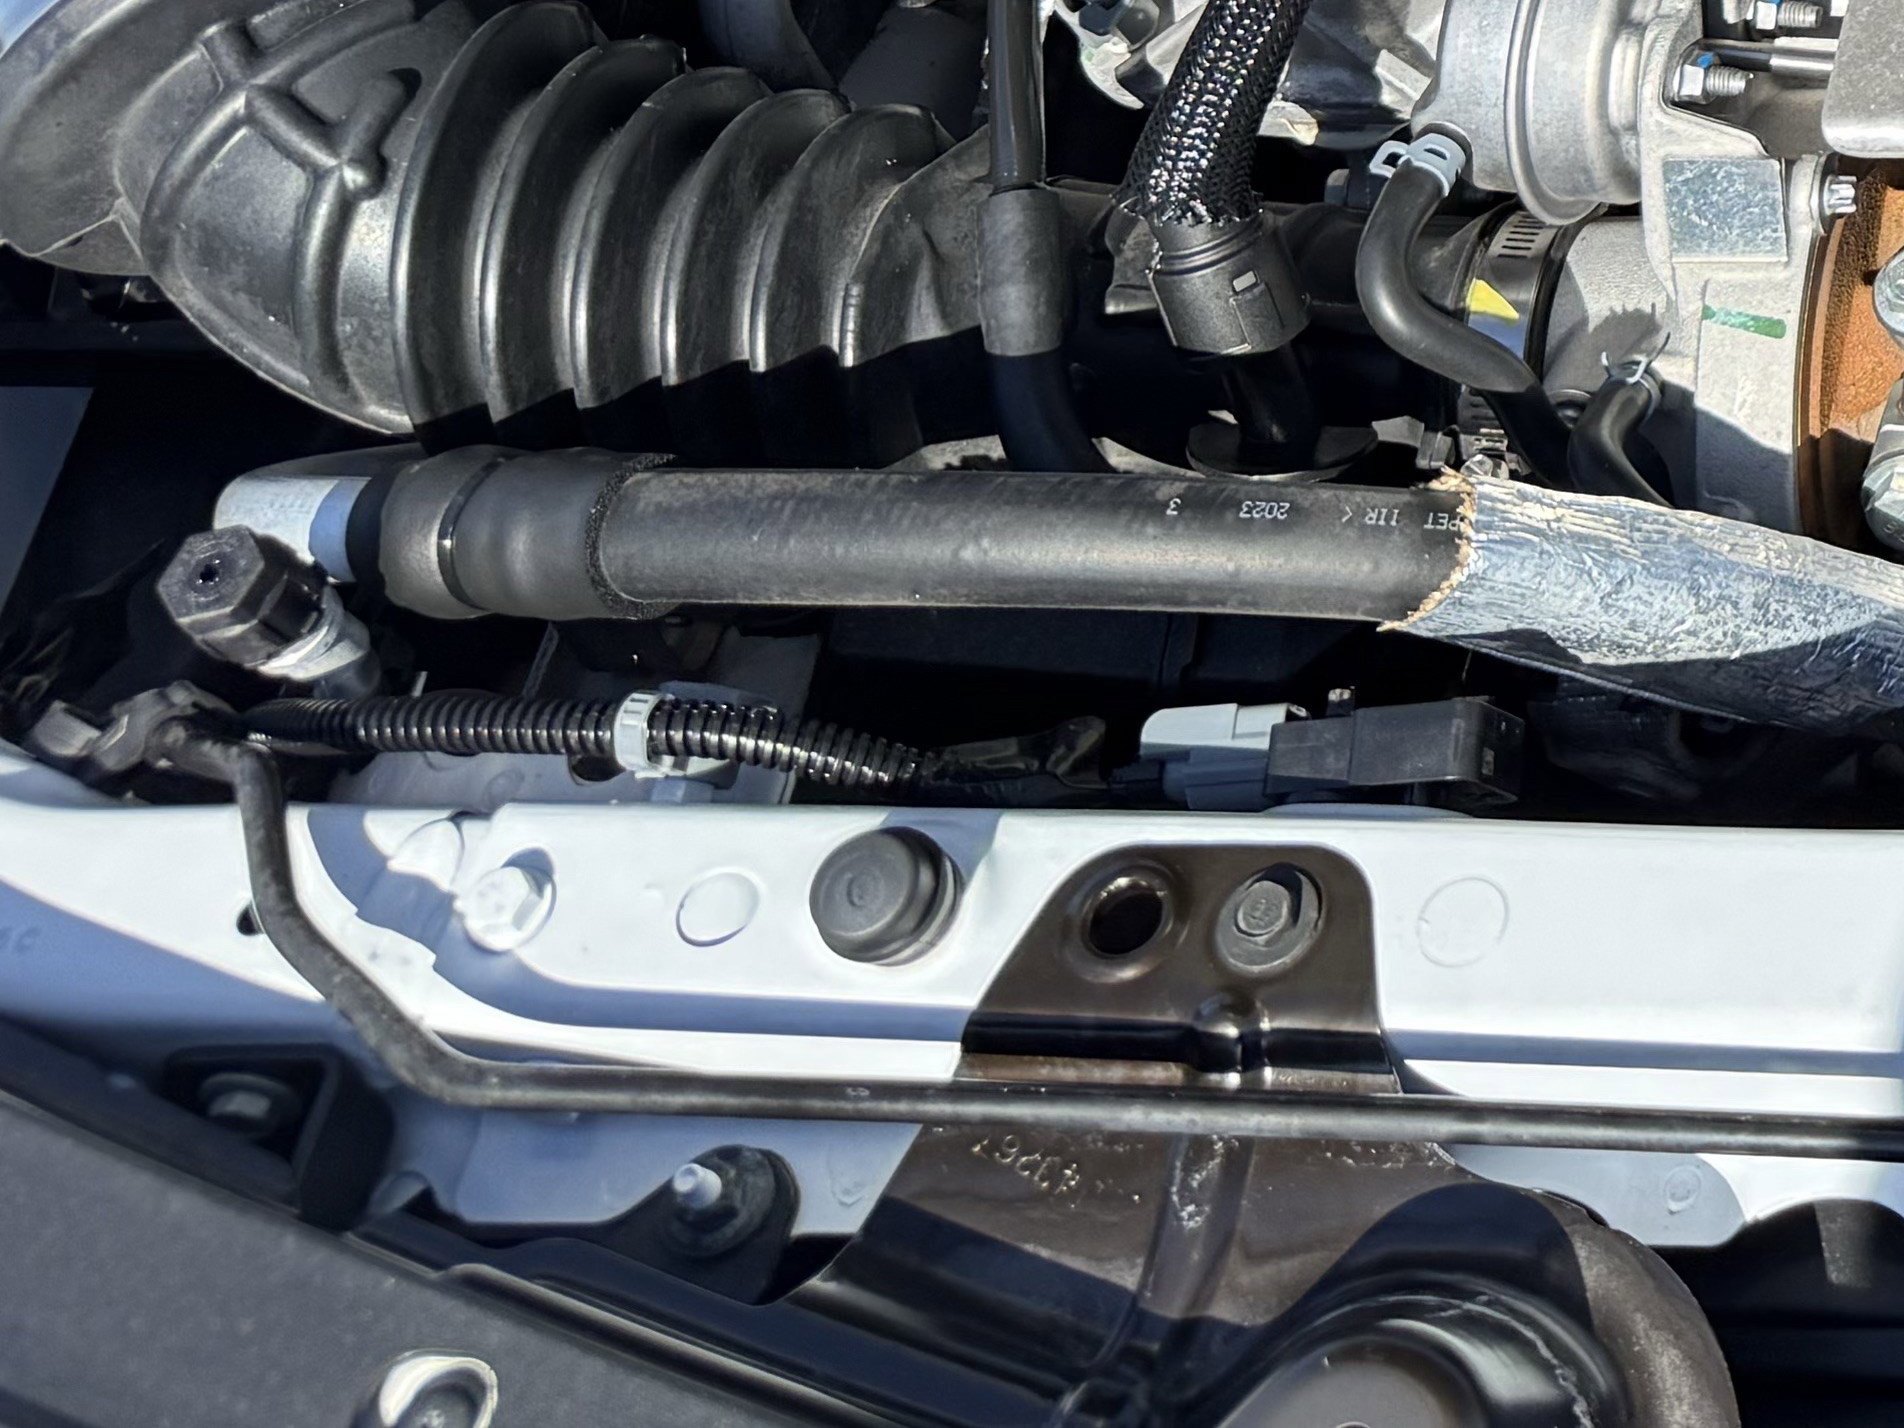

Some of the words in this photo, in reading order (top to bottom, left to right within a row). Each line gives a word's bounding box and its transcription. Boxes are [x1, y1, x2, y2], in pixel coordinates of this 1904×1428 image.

[1165, 497, 1182, 516] 3
[1238, 500, 1291, 520] 2023
[1423, 511, 1464, 532] PET
